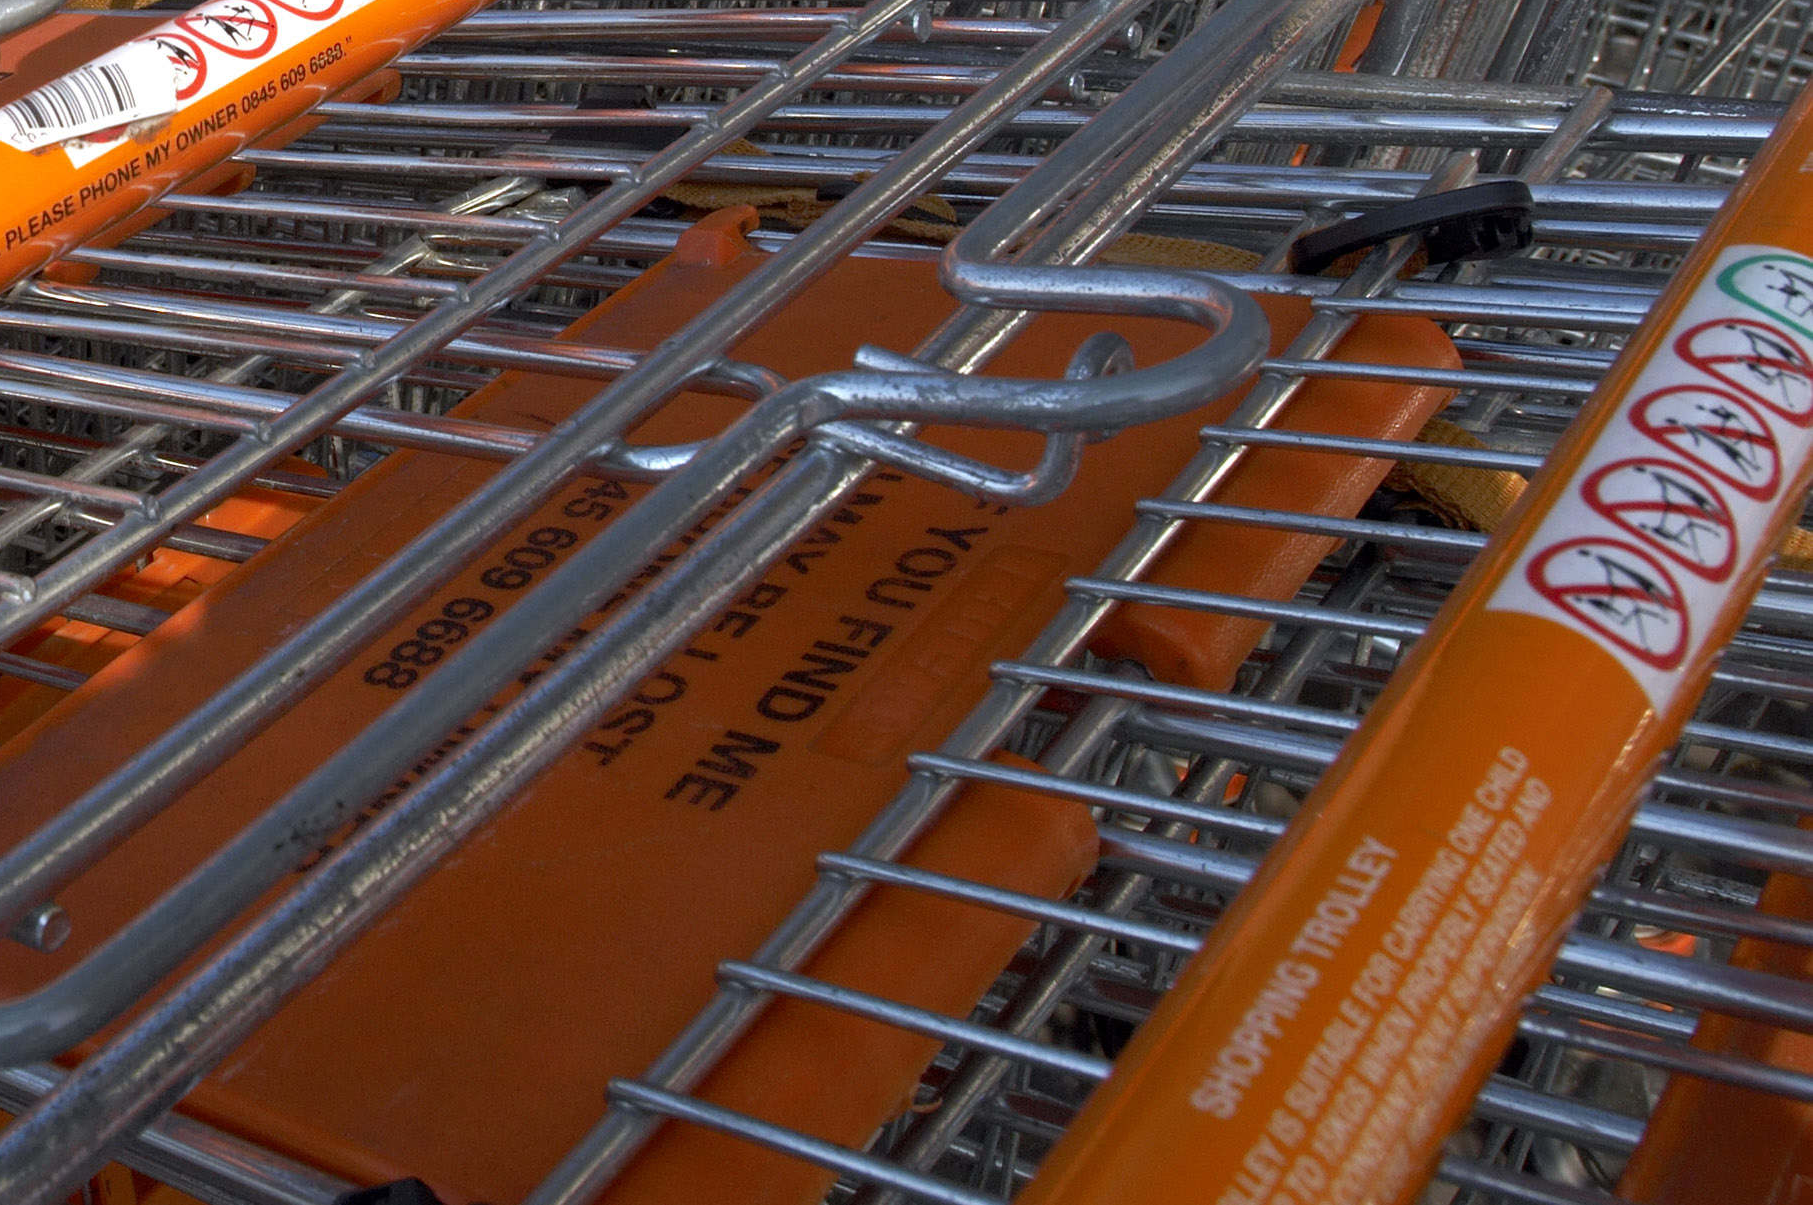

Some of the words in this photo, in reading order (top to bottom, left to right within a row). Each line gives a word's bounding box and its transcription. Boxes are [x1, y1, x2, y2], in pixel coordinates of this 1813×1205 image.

[5, 196, 75, 250] PLEASE
[80, 158, 140, 207] PHONE
[145, 141, 169, 169] MY
[176, 103, 237, 151] OWNER
[241, 80, 276, 113] 0845
[280, 64, 306, 91] 609
[481, 526, 578, 591] 609
[865, 526, 988, 608] YOU
[363, 596, 493, 690] 6688
[756, 617, 893, 724] FIND
[663, 729, 779, 813] ME
[1350, 950, 1402, 1010] FOR
[1447, 803, 1491, 855] ONE
[1475, 745, 1528, 807] CHILD
[1190, 956, 1320, 1119] SHOPPING
[1294, 834, 1399, 960] TROLLEY
